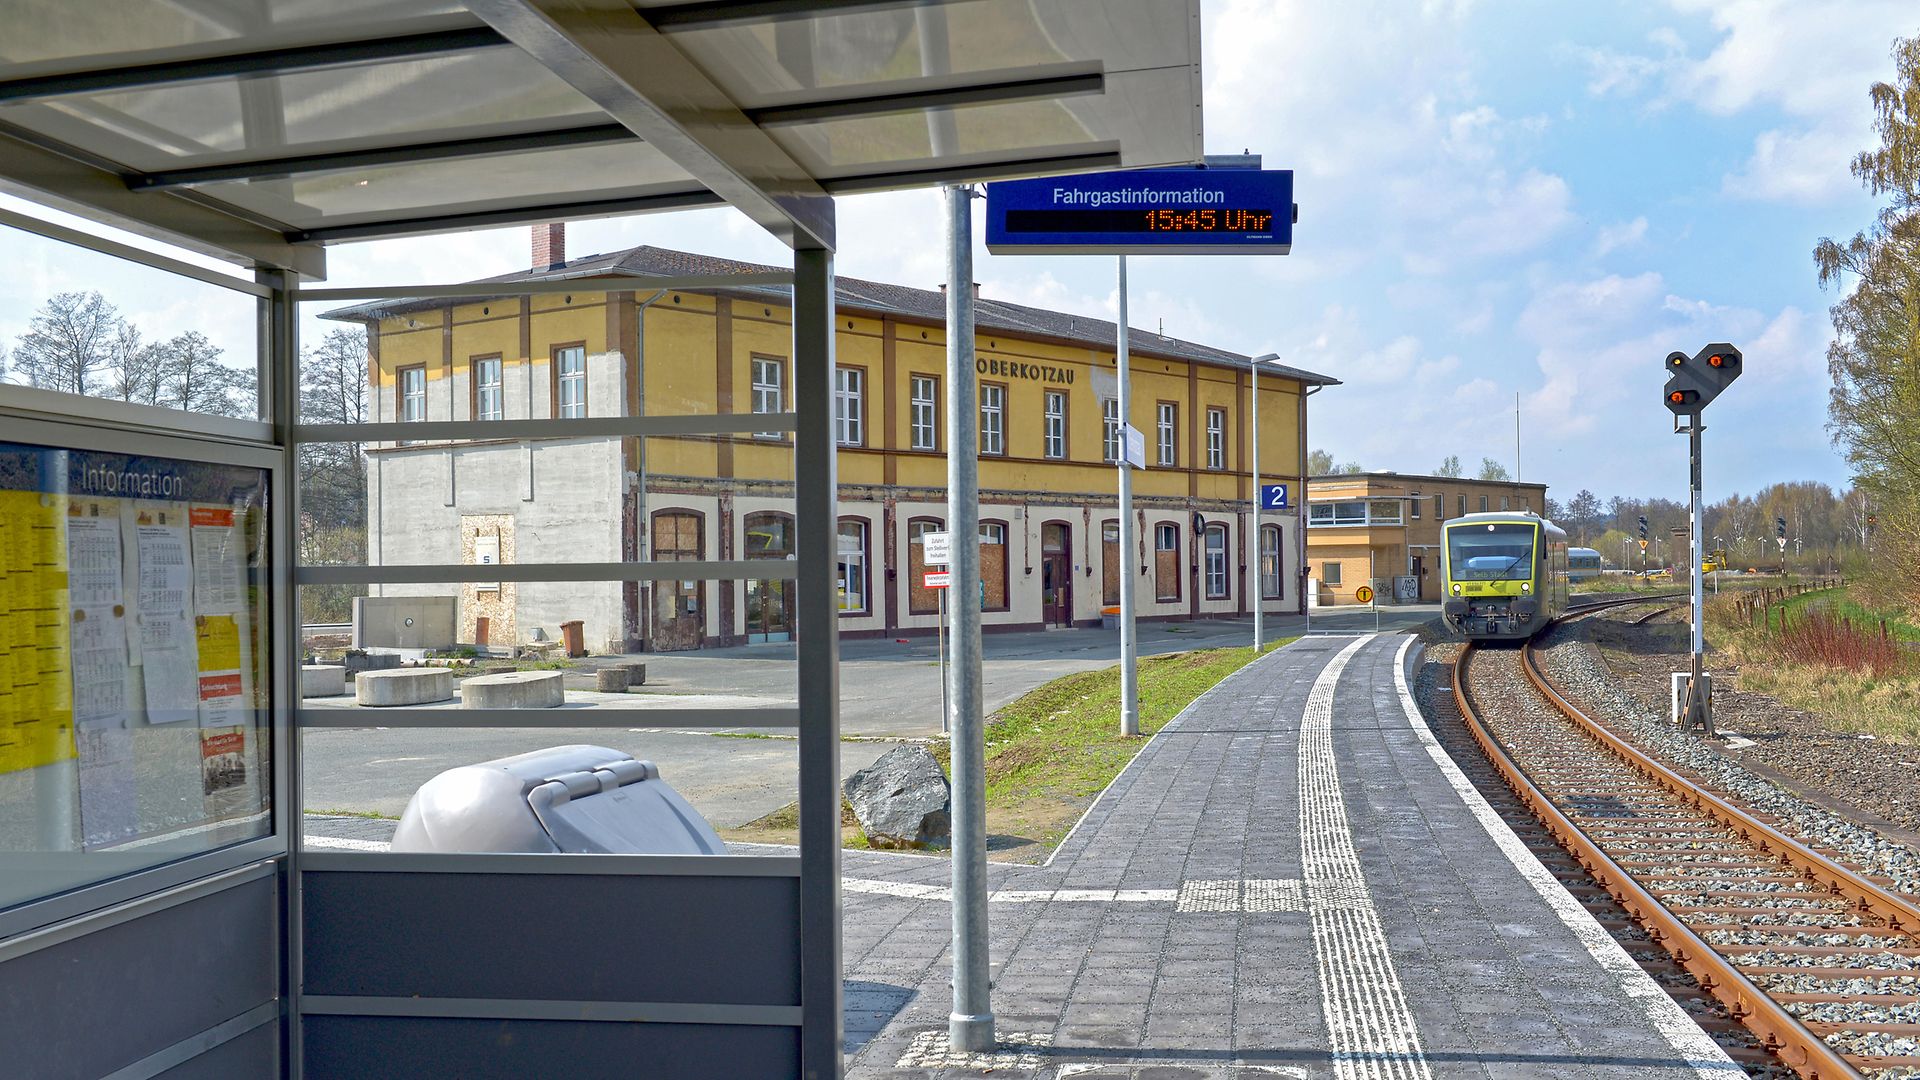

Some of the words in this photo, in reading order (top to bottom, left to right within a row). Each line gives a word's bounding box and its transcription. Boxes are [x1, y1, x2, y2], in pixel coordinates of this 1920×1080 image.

[1053, 188, 1224, 207] Fahrgastinformation
[1145, 210, 1215, 230] 15:45
[1226, 210, 1272, 230] Uhr
[976, 358, 1074, 385] OBERKOTZAU
[82, 461, 182, 495] Information
[1271, 486, 1284, 506] 2
